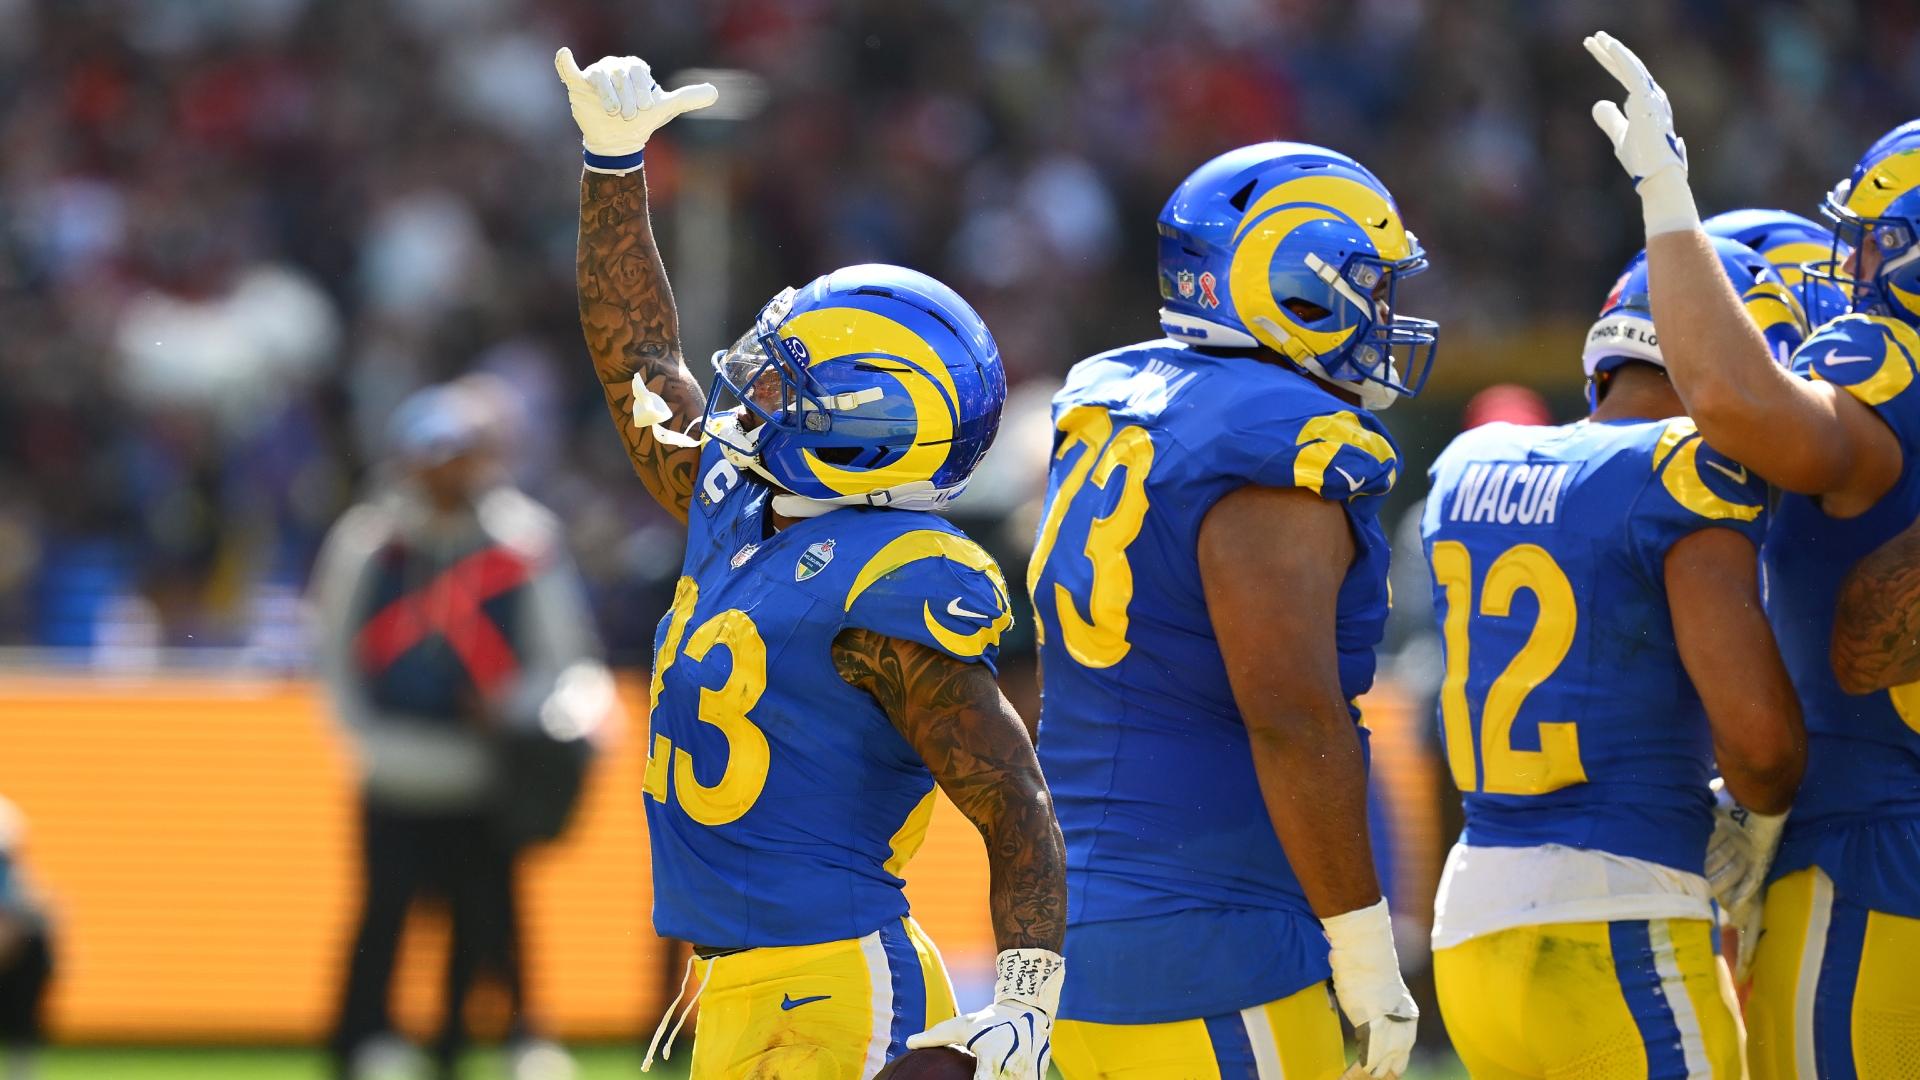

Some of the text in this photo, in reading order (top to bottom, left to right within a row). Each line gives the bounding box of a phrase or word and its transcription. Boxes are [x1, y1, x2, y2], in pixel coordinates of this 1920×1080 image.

[785, 339, 806, 368] OAKLEY
[1639, 331, 1658, 346] LO
[703, 458, 738, 504] C
[1449, 463, 1569, 525] NACUA
[1028, 405, 1155, 669] 73
[1431, 540, 1589, 796] 12
[642, 574, 771, 827] 23
